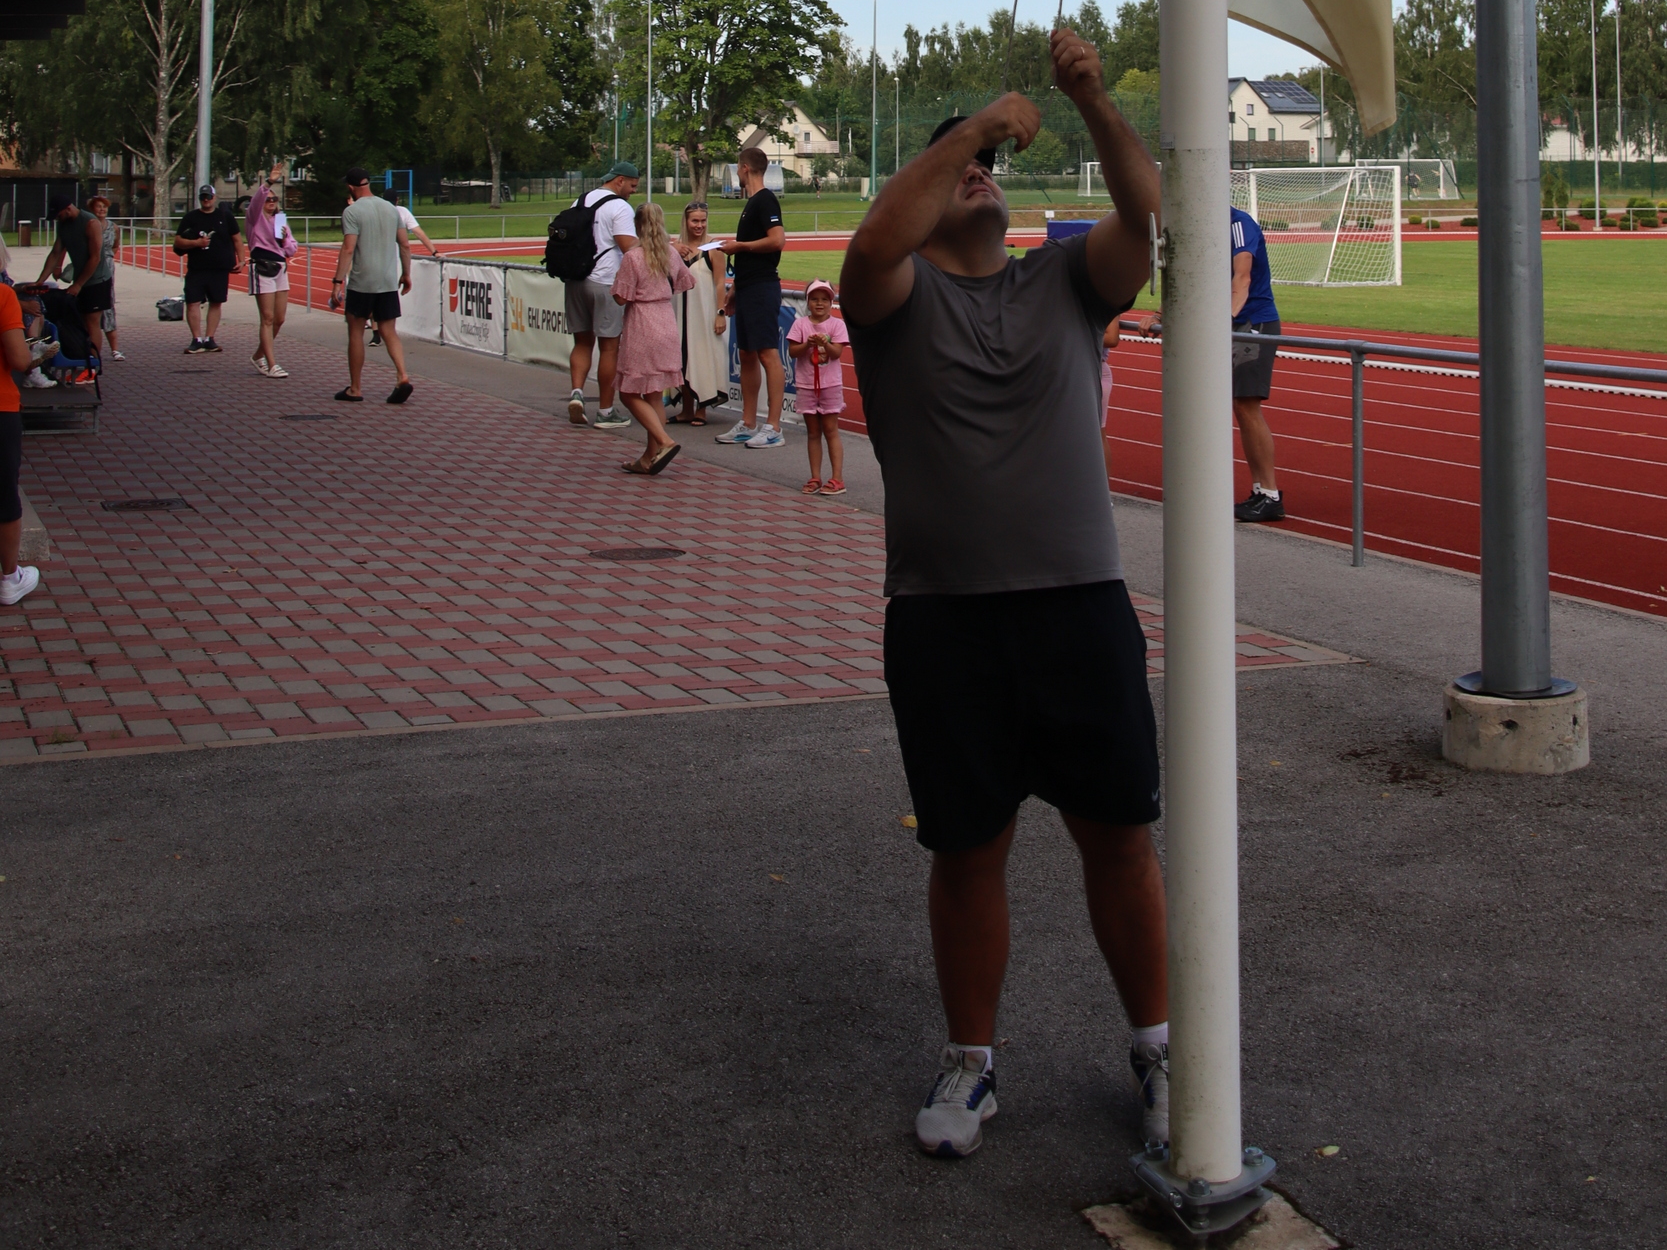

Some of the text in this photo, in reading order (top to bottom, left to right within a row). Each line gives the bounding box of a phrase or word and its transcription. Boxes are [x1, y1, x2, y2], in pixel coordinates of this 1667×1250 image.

[459, 280, 492, 320] TEFIRE
[528, 307, 572, 334] EHL PROFIL
[729, 388, 742, 401] GEN
